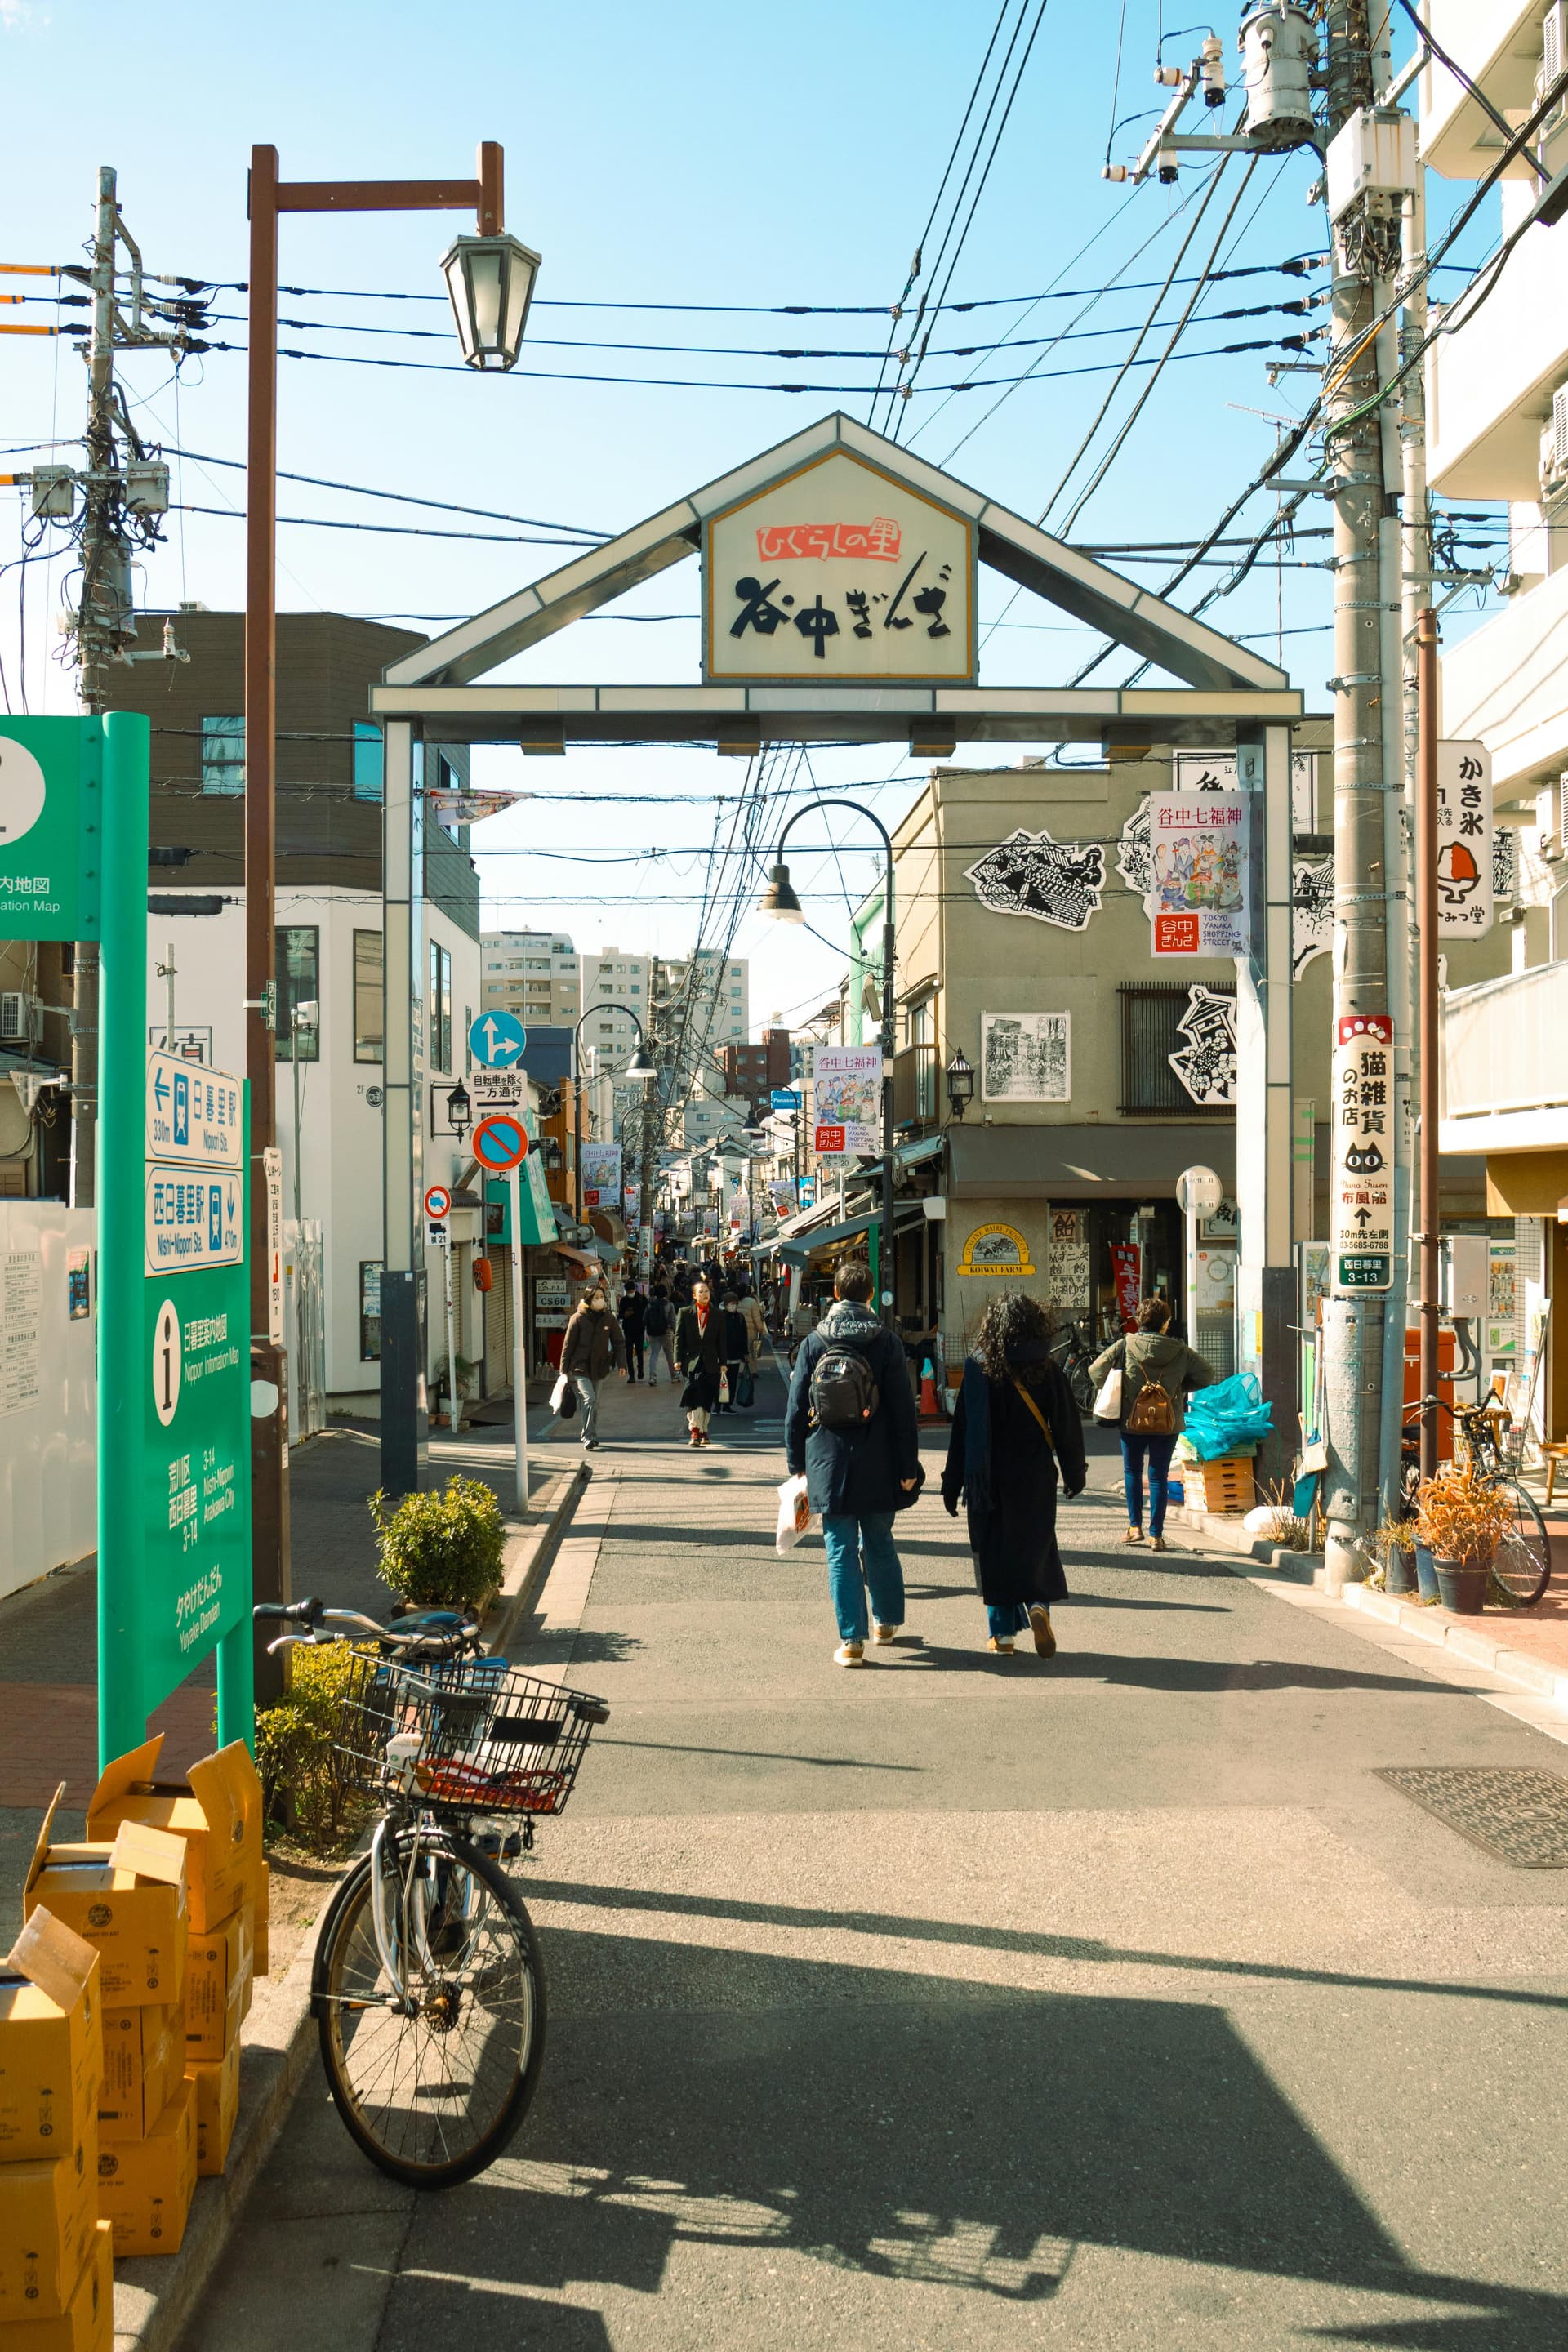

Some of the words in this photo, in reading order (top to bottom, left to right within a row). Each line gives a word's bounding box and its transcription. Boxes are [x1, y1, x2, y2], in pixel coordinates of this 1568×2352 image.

[759, 517, 901, 561] ひぐらしの里
[729, 551, 952, 658] 谷中ぎんざ
[1459, 756, 1484, 836] かき氷
[1157, 807, 1242, 826] 谷中七福神
[33, 900, 60, 913] Map
[1437, 906, 1485, 924] みつ堂
[1161, 920, 1193, 933] 谷中
[1203, 930, 1241, 938] SHOPPING
[1161, 933, 1194, 947] ぎんざ
[1203, 938, 1231, 947] STREET
[819, 1057, 877, 1069] 谷中七福神
[474, 1074, 522, 1085] 自転車を除く
[474, 1086, 523, 1098] 一方通行
[194, 1080, 237, 1128] 日暮里駅
[1343, 1068, 1359, 1125] のお店
[1361, 1051, 1387, 1135] 猫雑貨
[203, 1128, 219, 1156] Nippori
[819, 1138, 841, 1148] ぎんざ
[820, 1129, 841, 1139] 谷中
[1364, 1178, 1388, 1189] Fusen
[154, 1183, 204, 1225] 西日暮里駅
[1342, 1191, 1387, 1205] 布風船
[158, 1232, 193, 1260] Nishi-Nippori
[1005, 1227, 1027, 1255] PRODUCTS
[1339, 1241, 1388, 1250] 03-5685-6788
[1340, 1229, 1388, 1240] 30m先左側
[1344, 1259, 1382, 1270] 西日暮里
[1348, 1272, 1378, 1283] 3-13
[185, 1313, 227, 1352] 日暮里案内地図
[185, 1355, 203, 1388] Nippori
[229, 1346, 239, 1369] Map
[203, 1446, 216, 1471] 3-14
[169, 1454, 191, 1494] 荒川区
[203, 1461, 234, 1497] Nishi-Nippori
[169, 1484, 198, 1530] 西日暮里
[203, 1496, 225, 1525] Arakawa
[225, 1488, 234, 1509] City
[183, 1518, 198, 1552] 3-14
[176, 1564, 223, 1628] 夕やけだんだん
[180, 1620, 199, 1653] Yuyake
[199, 1600, 220, 1633] Dandan
